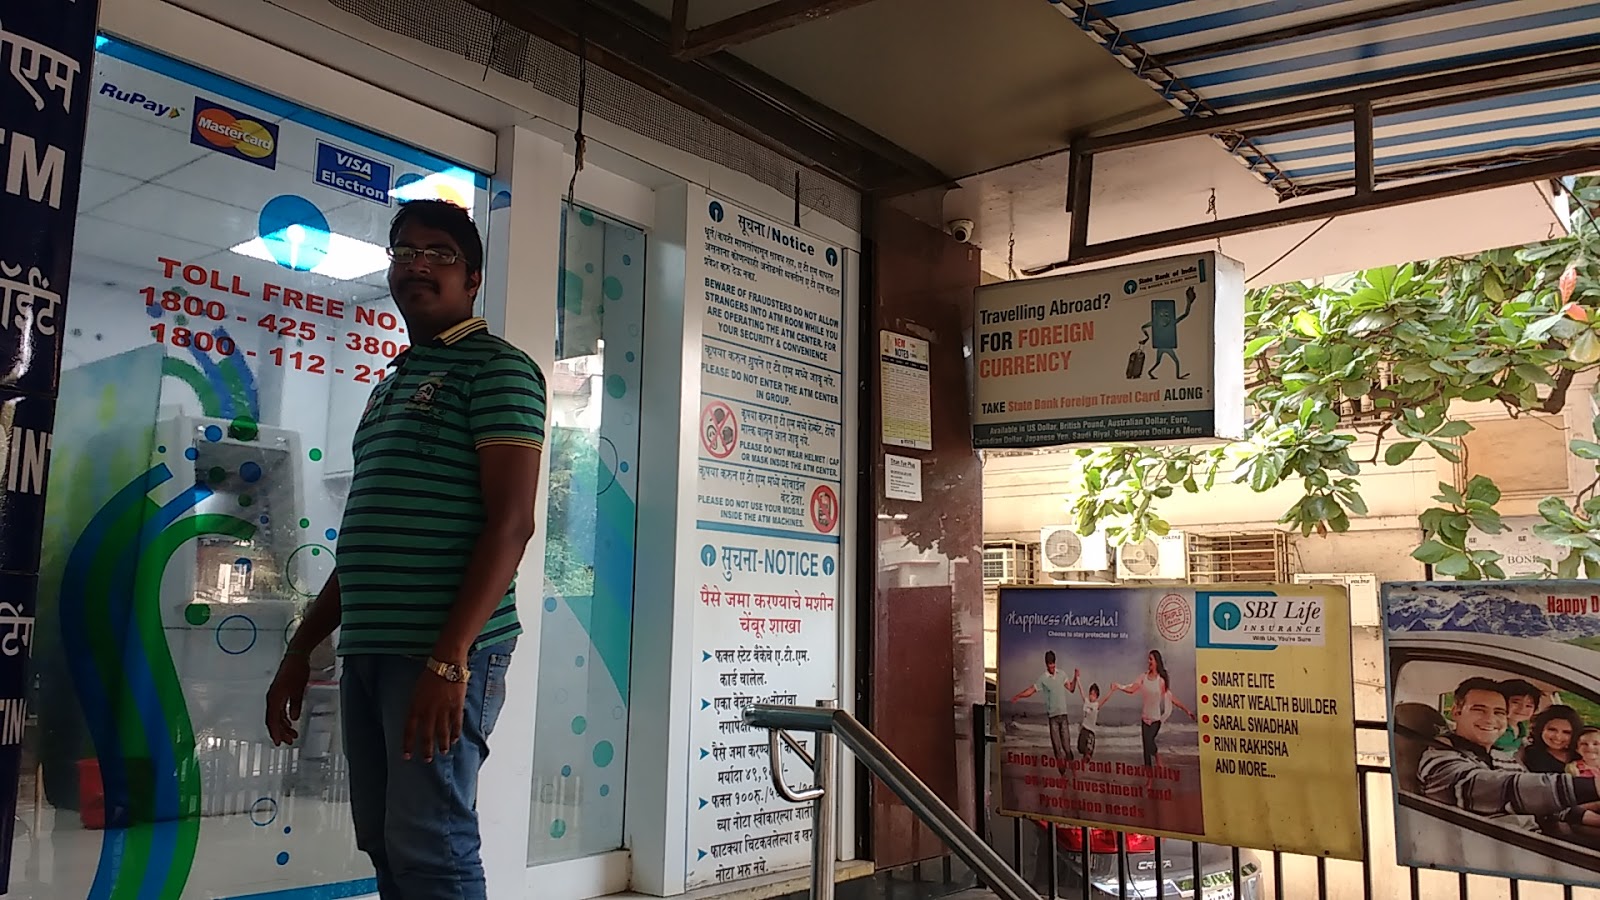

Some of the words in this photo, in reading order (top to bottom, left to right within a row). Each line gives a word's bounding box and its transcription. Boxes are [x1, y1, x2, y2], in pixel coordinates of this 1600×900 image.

[99, 82, 170, 118] RuPay
[197, 116, 271, 150] MasterCard
[0, 127, 66, 210] M
[335, 152, 372, 175] VISA
[320, 169, 386, 200] Electron
[1155, 272, 1170, 281] Bank
[157, 256, 251, 297] TOLL
[262, 282, 345, 319] FREE
[354, 305, 405, 333] NO.
[705, 277, 736, 295] BEWARE
[737, 288, 747, 298] OF
[748, 291, 792, 313] FRAUDSTERS
[793, 305, 803, 316] DO
[804, 309, 817, 321] NOT
[818, 314, 839, 328] ALLOW
[139, 286, 225, 321] 1800
[257, 313, 316, 341] 425
[705, 291, 749, 312] STRANGERS
[750, 305, 767, 318] INTO
[768, 311, 783, 323] ATM
[784, 316, 804, 329] ROOM
[804, 322, 824, 336] WHILE
[825, 328, 838, 340] YOU
[980, 304, 1045, 325] Travelling
[1049, 293, 1111, 316] Abroad?
[707, 306, 722, 318] ARE
[724, 311, 765, 330] OPERATING
[766, 323, 780, 335] THE
[780, 328, 795, 339] ATM
[824, 340, 836, 352] FOR
[718, 322, 738, 336] YOUR
[740, 329, 774, 346] SECURITY
[776, 339, 781, 348] &
[782, 341, 828, 362] CONVENIENCE
[980, 331, 1013, 352] FOR
[1018, 321, 1094, 348] FOREIGN
[150, 322, 235, 356] 1800
[269, 347, 325, 374] 112
[353, 364, 387, 384] 21
[980, 350, 1071, 378] CURRENCY
[701, 362, 729, 378] PLEASE
[731, 370, 741, 380] DO
[743, 373, 758, 384] NOT
[760, 377, 783, 391] ENTER
[784, 383, 798, 395] THE
[799, 387, 814, 398] ATM
[814, 391, 839, 404] CENTER
[756, 390, 764, 399] IN
[765, 392, 791, 406] GROUP.
[981, 401, 1006, 414] TAKE
[1008, 400, 1033, 412] State
[1034, 398, 1058, 410] Bank
[1060, 395, 1098, 409] Foreign
[1100, 391, 1135, 405] Travel
[1135, 390, 1160, 402] Card
[1164, 387, 1203, 401] ALONG
[1027, 424, 1036, 432] US
[1060, 421, 1081, 430] British
[1107, 417, 1143, 427] Australian
[1114, 428, 1150, 439] Singapore
[1152, 427, 1174, 436] Dollar
[1183, 426, 1203, 435] More
[700, 584, 721, 607] पैसे
[724, 592, 751, 608] जमा
[753, 589, 801, 610] करण्याचे
[804, 592, 834, 612] मशीन
[1547, 595, 1587, 615] Happy
[739, 611, 766, 639] चेंबूर
[768, 618, 801, 635] शाखा
[1005, 610, 1060, 633] Happiness
[1061, 609, 1118, 627] Hamesha!
[1243, 600, 1278, 619] SBI
[1283, 601, 1321, 625] Life
[1243, 624, 1321, 633] INSURANCE
[740, 668, 767, 687] चालेल.
[1212, 671, 1245, 688] SMART
[1247, 673, 1275, 689] ELITE
[1212, 693, 1246, 709] SMART
[1247, 694, 1289, 712] WEALTH
[1292, 697, 1337, 715] BUILDER
[1213, 714, 1246, 731] SARAL
[1248, 717, 1298, 735] SWADHAN
[712, 741, 727, 762] पैसे
[729, 745, 747, 760] जमा
[1214, 736, 1237, 753] RINN
[1240, 738, 1289, 757] RAKHSHA
[1007, 751, 1038, 767] Enjoy
[1089, 761, 1111, 774] and
[1215, 758, 1236, 774] AND
[1238, 760, 1276, 778] MORE...
[1105, 803, 1145, 818] needs
